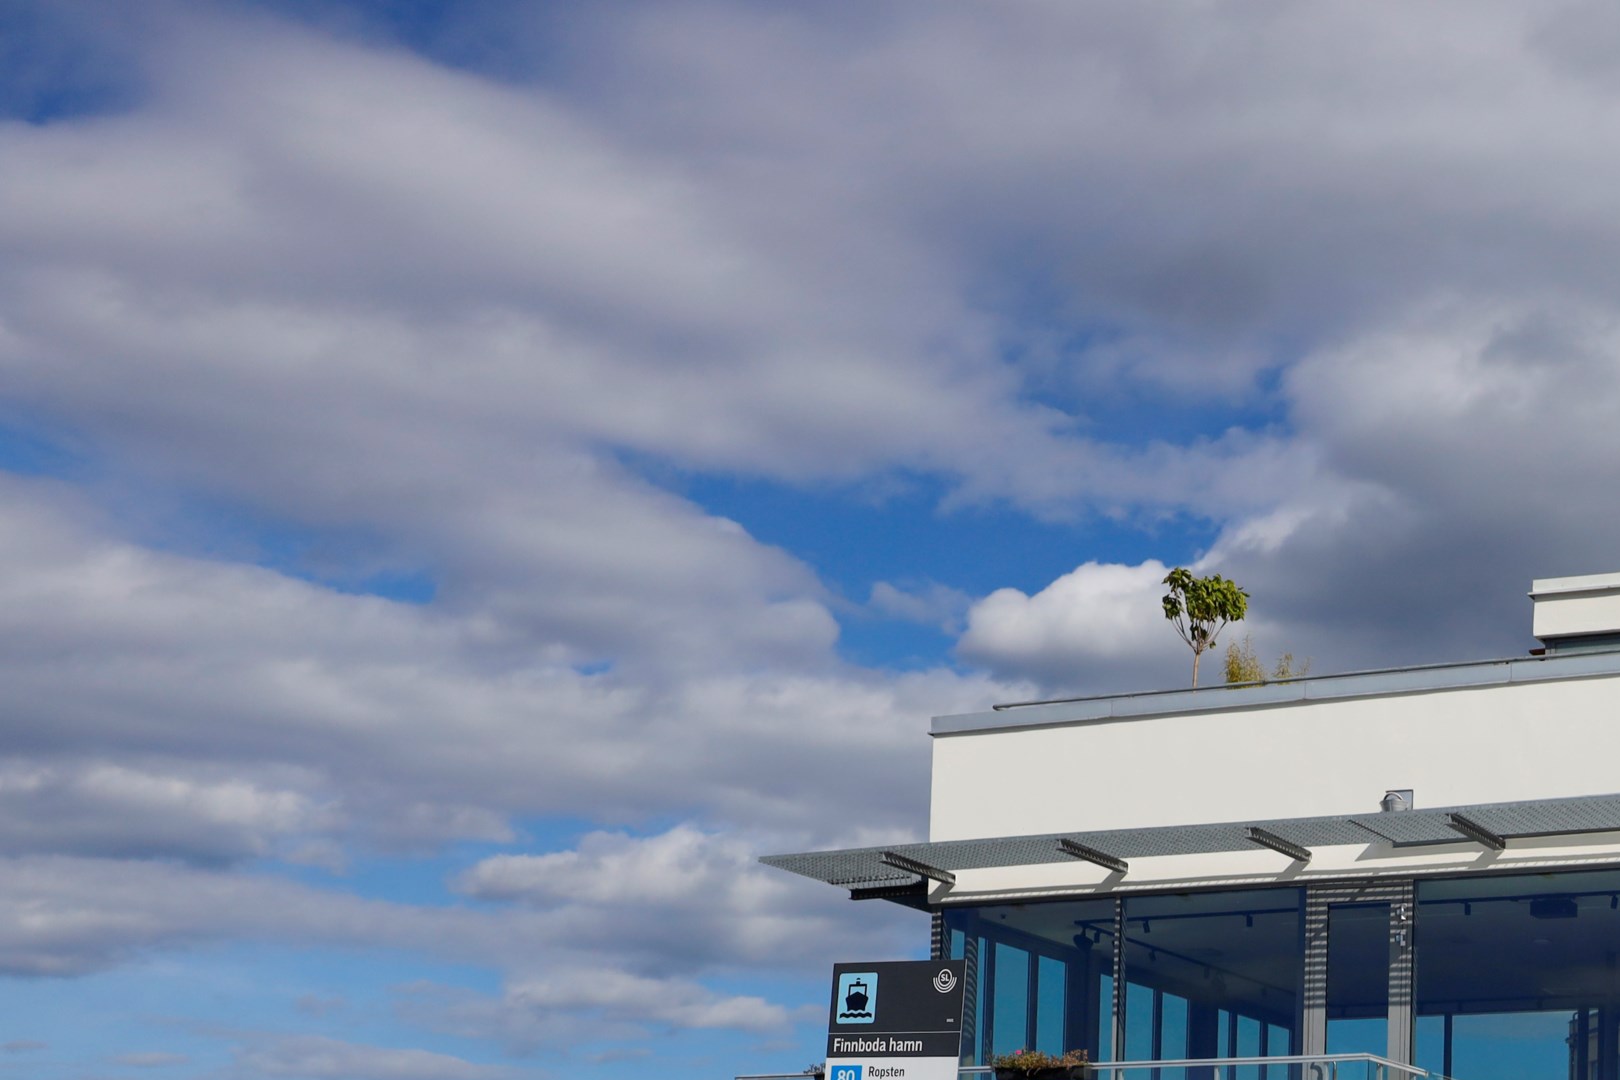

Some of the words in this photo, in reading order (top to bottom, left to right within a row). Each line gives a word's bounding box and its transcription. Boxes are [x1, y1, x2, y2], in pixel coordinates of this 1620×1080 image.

[940, 973, 950, 982] SL
[833, 1037, 886, 1053] Finnboda
[888, 1037, 923, 1052] hamn
[868, 1066, 905, 1079] Ropsten
